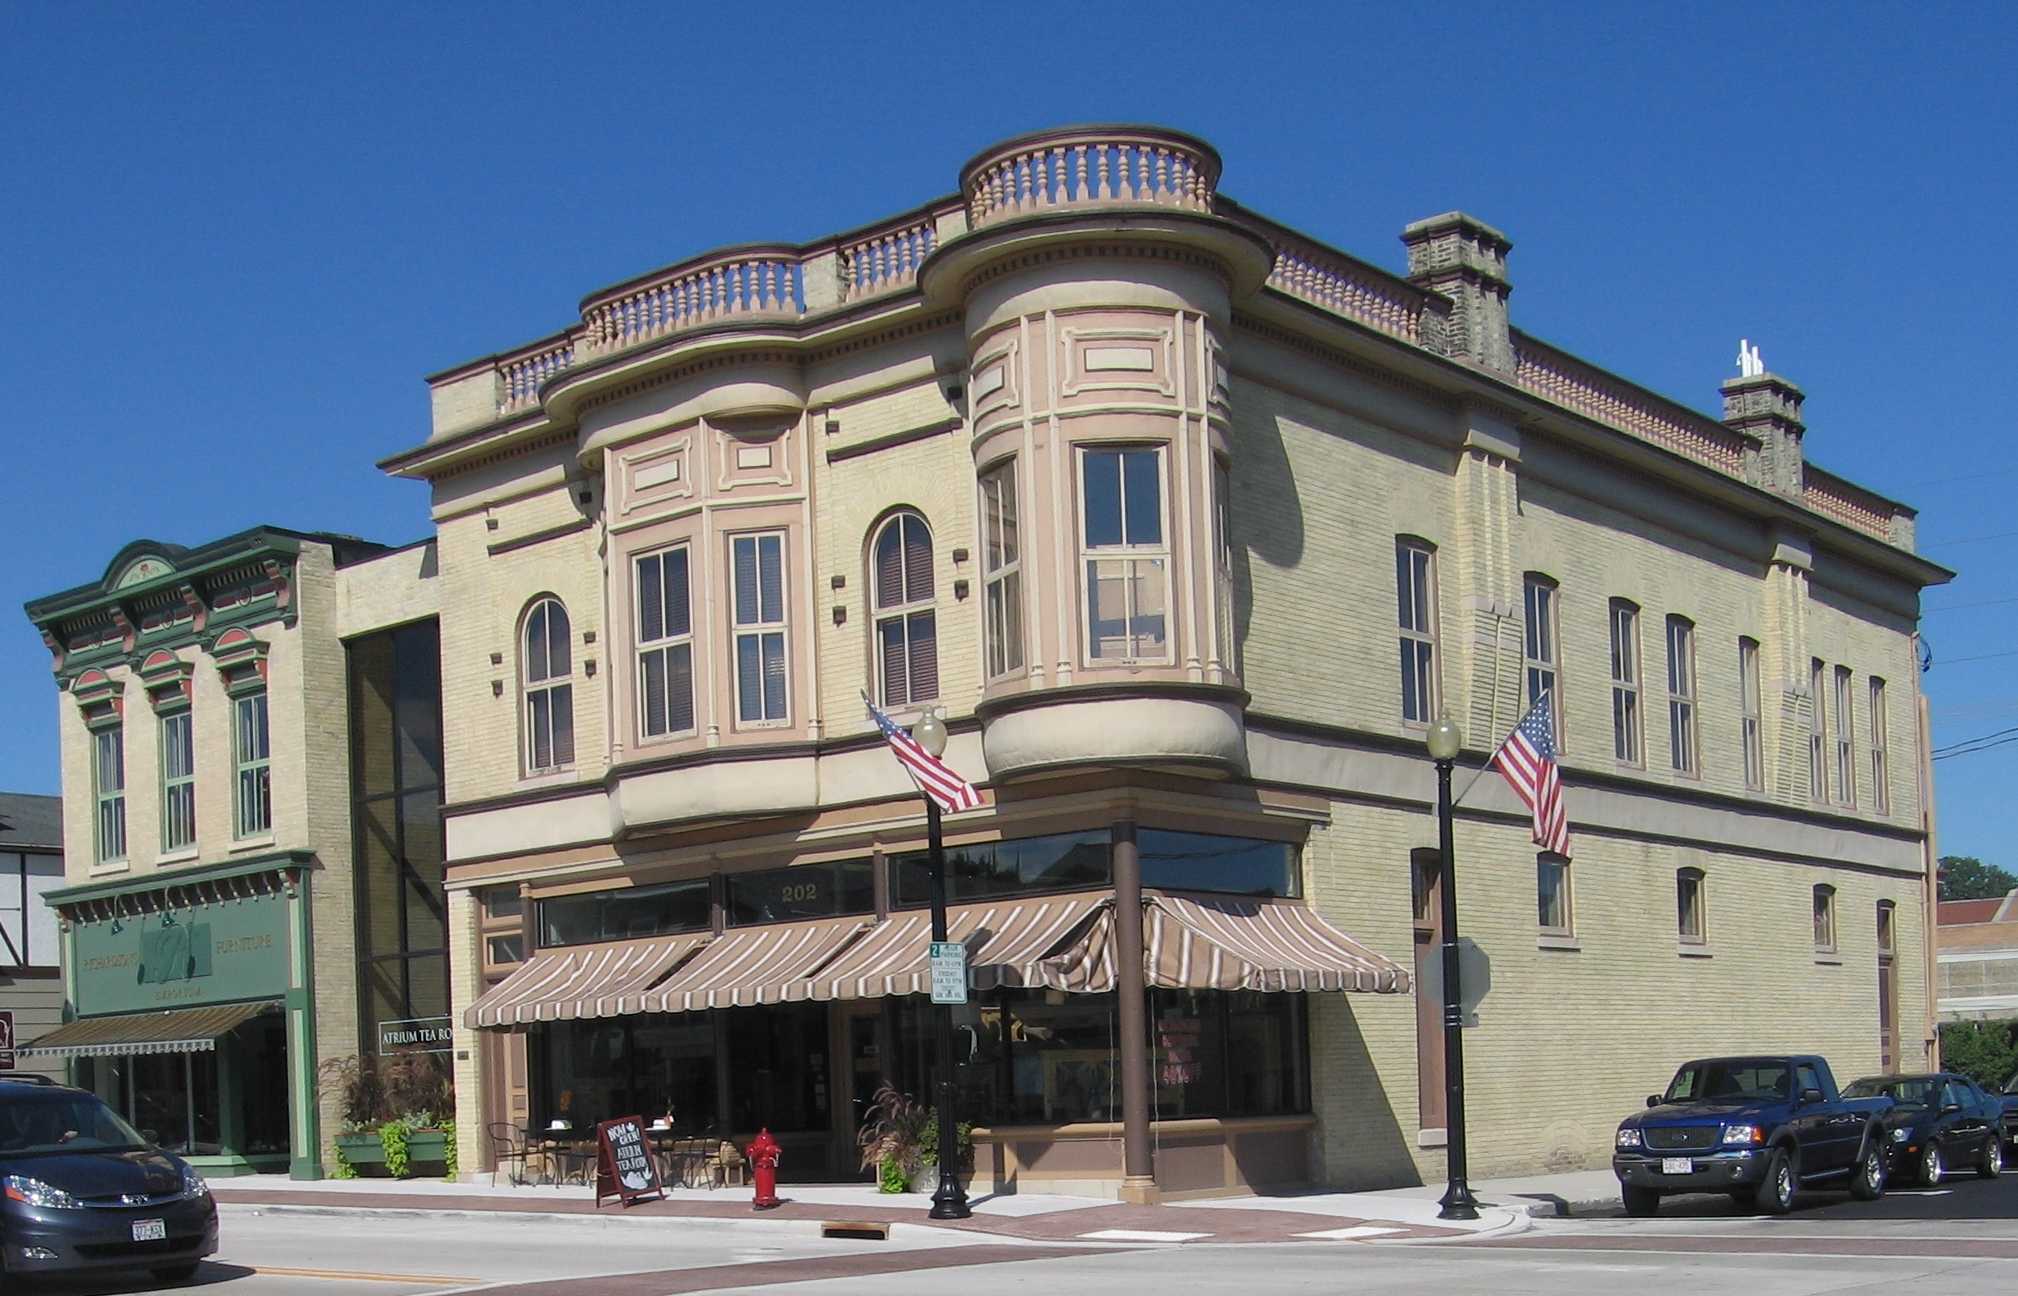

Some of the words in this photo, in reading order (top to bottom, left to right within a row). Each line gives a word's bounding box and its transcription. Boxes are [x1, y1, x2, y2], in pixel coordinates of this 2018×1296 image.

[782, 884, 817, 902] 202
[217, 935, 272, 954] FURNITURE
[931, 944, 938, 956] 2
[155, 986, 203, 1000] EMPORIUM
[382, 1031, 417, 1044] ATRIUM
[419, 1029, 436, 1042] TEA
[607, 1123, 627, 1141] NOW
[616, 1160, 631, 1171] TEA
